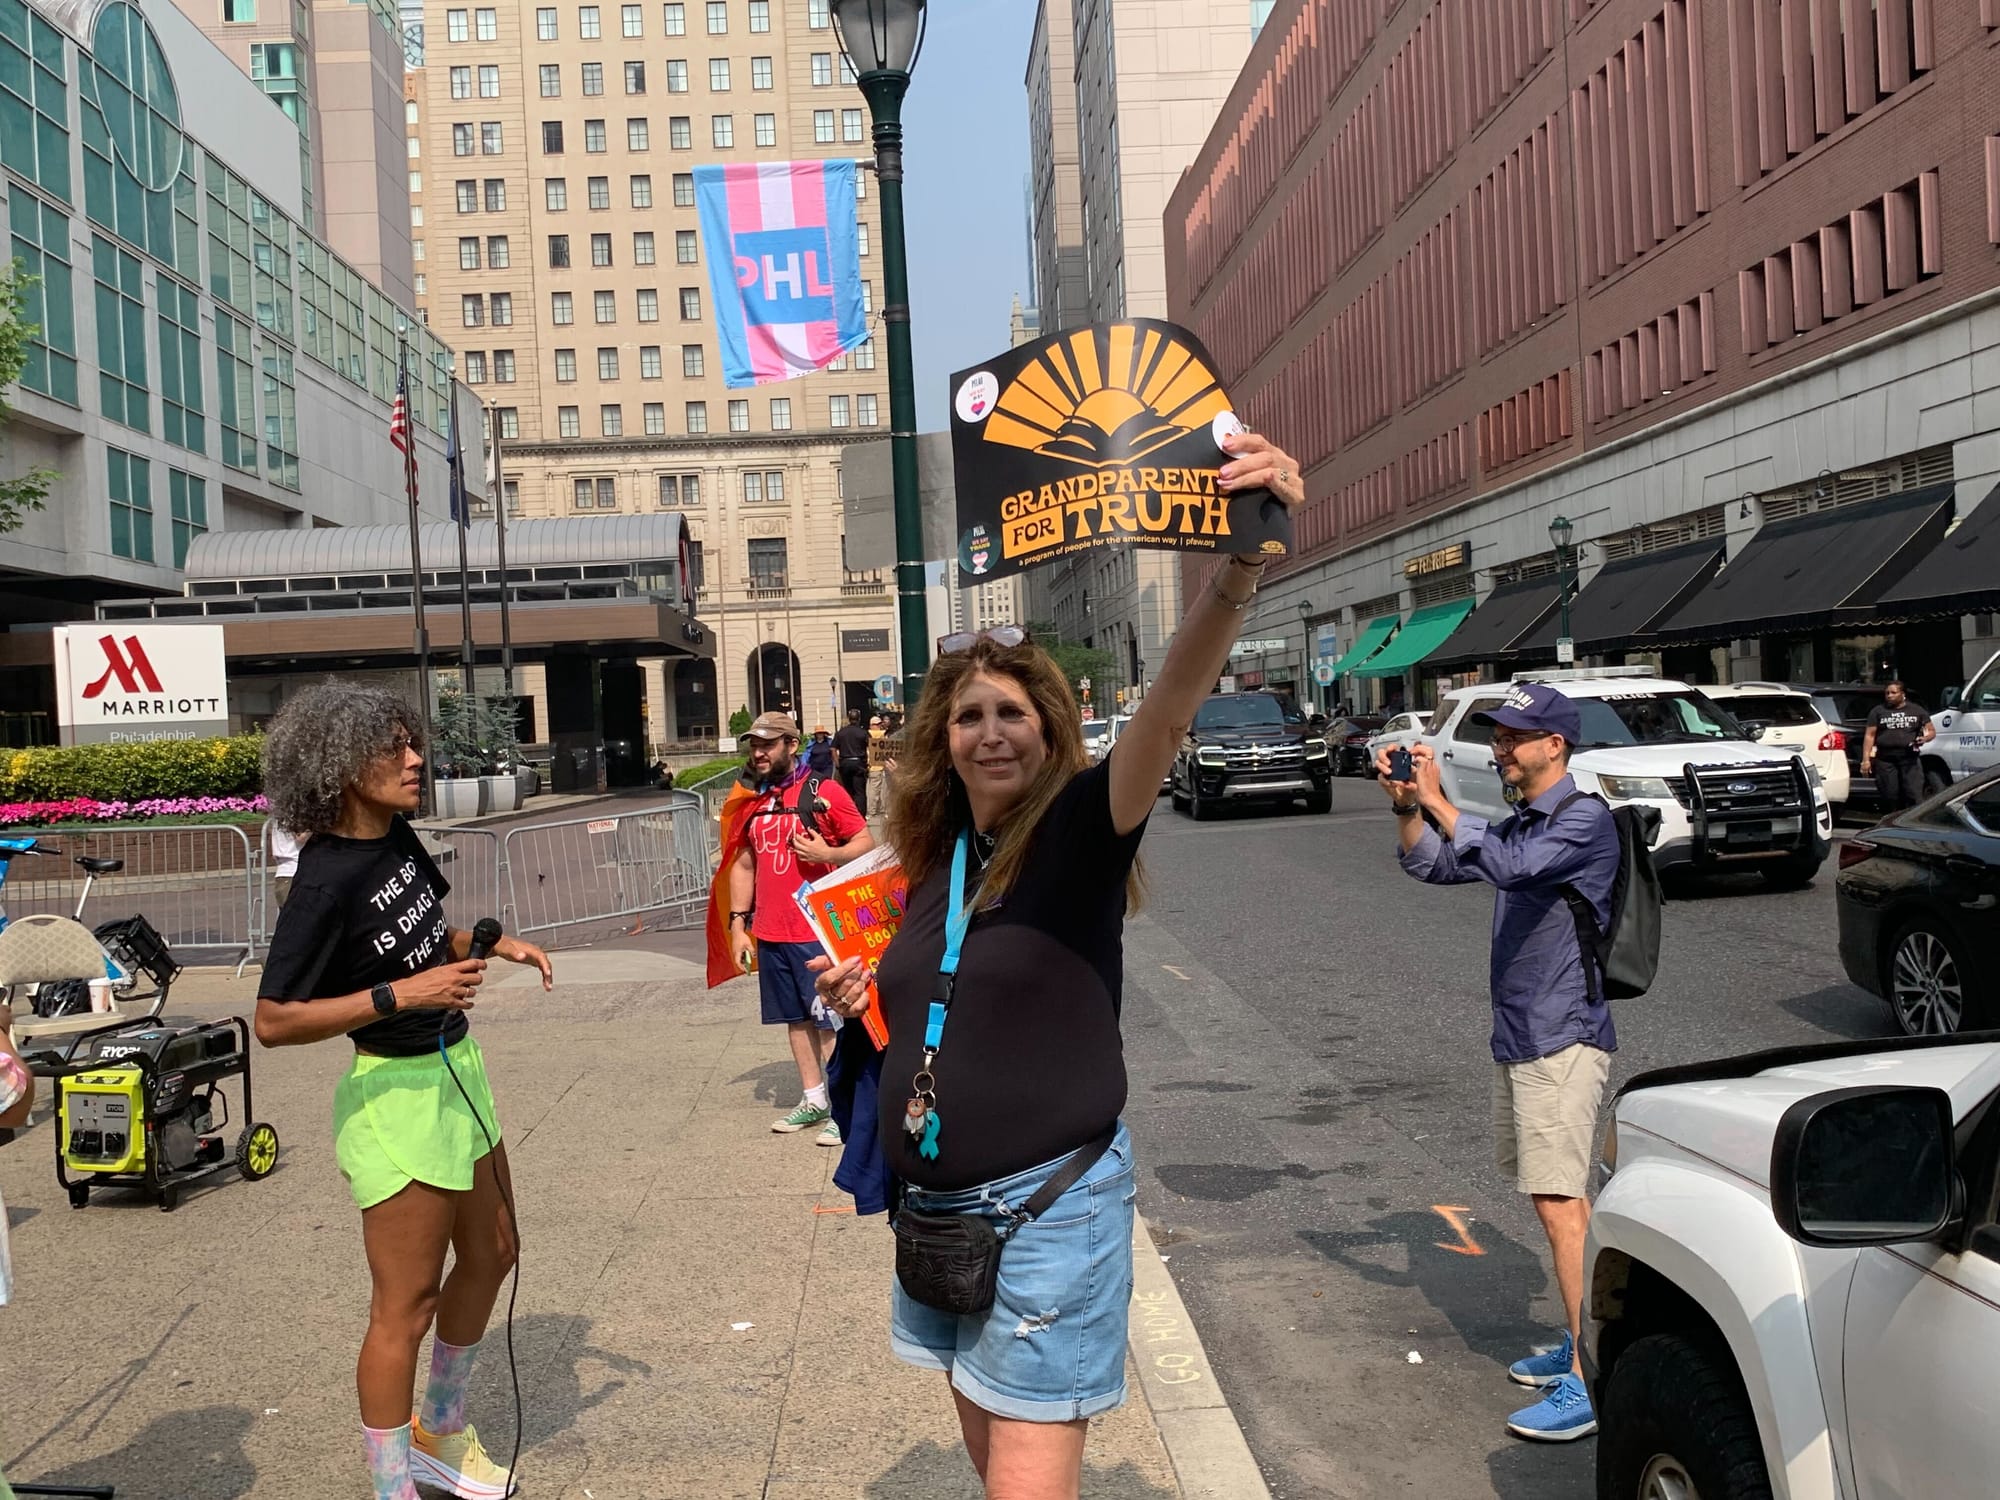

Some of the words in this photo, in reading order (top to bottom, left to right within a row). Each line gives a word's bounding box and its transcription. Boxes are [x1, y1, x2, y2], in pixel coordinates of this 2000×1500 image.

[735, 251, 834, 301] PHL
[1001, 467, 1230, 522] GRANDPARENT
[1013, 517, 1055, 547] FOR
[1066, 493, 1232, 540] TRUTH
[1024, 550, 1055, 567] program
[1055, 544, 1063, 555] of
[1064, 541, 1091, 554] people
[1092, 538, 1105, 547] for
[1106, 536, 1120, 545] the
[1122, 535, 1161, 544] american
[1161, 537, 1178, 546] way
[1186, 537, 1216, 548] pfaw.org
[1234, 640, 1267, 649] ARK
[102, 698, 219, 716] MARRIOTT
[1960, 735, 1997, 746] WPVI-TV
[370, 877, 405, 911] THE
[400, 855, 418, 885] BO
[846, 883, 876, 905] THE
[373, 931, 397, 956] IS
[397, 893, 433, 935] DRAG
[828, 887, 907, 941] FAMILY
[403, 936, 433, 970] THE
[1133, 1291, 1182, 1343] HOME
[1154, 1353, 1201, 1384] GO
